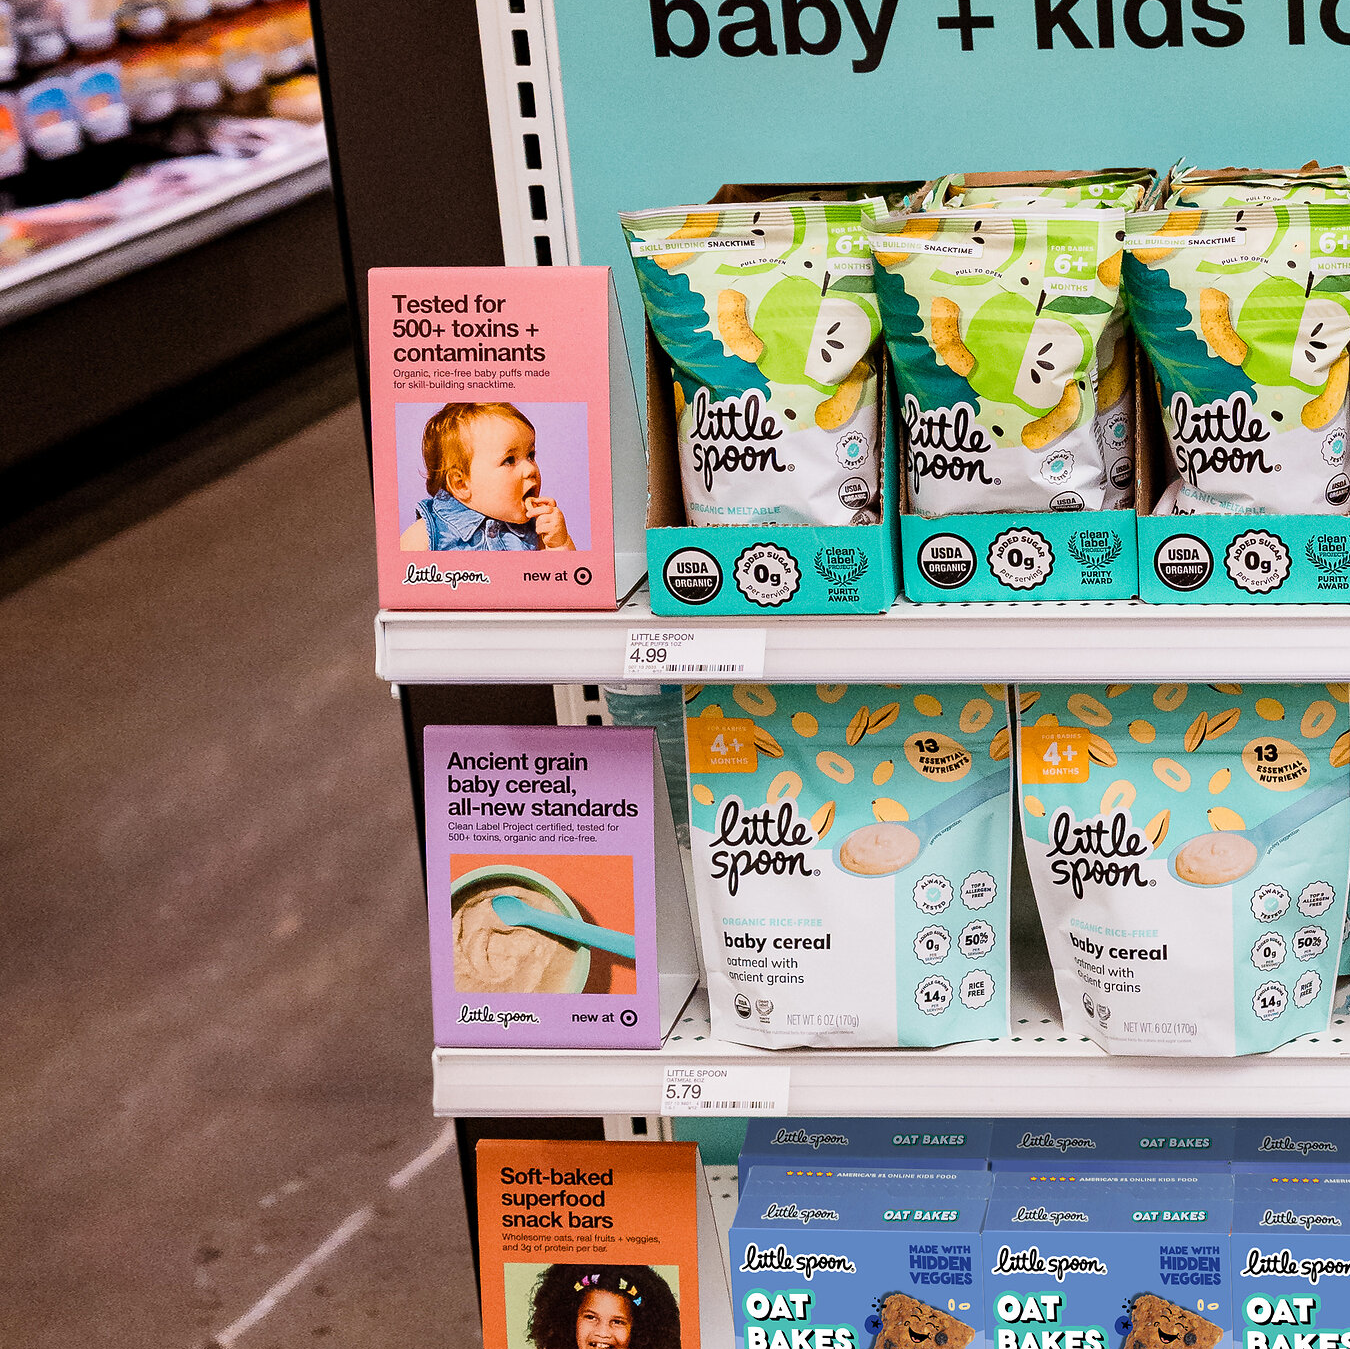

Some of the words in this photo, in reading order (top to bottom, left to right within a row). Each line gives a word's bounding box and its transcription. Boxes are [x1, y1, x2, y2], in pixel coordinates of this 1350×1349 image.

[640, 244, 663, 252] SKILL
[665, 241, 705, 250] BUILDING
[708, 239, 756, 248] SNACKTIME
[392, 295, 468, 314] Tested
[474, 295, 506, 314] for
[393, 319, 446, 338] 500+
[452, 319, 519, 338] toxins
[526, 324, 539, 336] +
[393, 343, 546, 362] contaminants
[393, 369, 430, 379] Organic,
[433, 369, 472, 378] rice-free
[474, 369, 496, 379] baby
[500, 369, 522, 379] puffs
[524, 369, 550, 378] made
[393, 381, 406, 389] for
[408, 380, 465, 391] skill-building
[467, 381, 516, 389] snacktime.
[690, 392, 783, 441] little
[404, 565, 443, 583] little
[677, 562, 708, 573] USDA
[754, 564, 781, 586] 0g
[524, 572, 551, 581] new
[555, 571, 568, 581] at
[675, 579, 713, 588] ORGANIC
[630, 648, 667, 663] 4.99
[915, 739, 939, 753] 13
[447, 752, 529, 771] Ancient
[534, 753, 588, 774] grain
[919, 752, 964, 764] ESSENTIAL
[923, 757, 969, 773] NUTRIENTS
[448, 775, 500, 797] baby
[505, 777, 577, 796] cereal,
[448, 799, 524, 816] all-new
[531, 799, 638, 817] standards
[448, 823, 473, 831] Clean
[476, 823, 499, 831] Label
[503, 823, 533, 833] Project
[536, 823, 574, 833] certified,
[577, 823, 604, 832] tested
[607, 823, 619, 832] for
[709, 800, 812, 848] little
[448, 833, 470, 842] 500+
[473, 833, 501, 843] toxins,
[504, 834, 536, 844] organic
[539, 834, 555, 842] and
[558, 834, 597, 843] rice-free.
[723, 918, 765, 926] ORGANIC
[770, 918, 822, 926] RICE-FREE
[724, 932, 767, 953] baby
[773, 934, 831, 950] cereal
[727, 957, 768, 968] oatmeal
[771, 958, 798, 968] with
[729, 971, 763, 982] ancient
[767, 973, 804, 985] grains
[787, 1015, 800, 1025] NET
[803, 1015, 814, 1025] WT
[817, 1015, 822, 1025] 6
[824, 1015, 834, 1025] OZ
[836, 1015, 859, 1027] (170g)
[666, 1085, 703, 1100] 5.79
[501, 1168, 613, 1186] Soft-baked
[501, 1191, 605, 1211] superfood
[502, 1212, 564, 1229] snack
[568, 1212, 613, 1229] bars
[502, 1233, 551, 1241] Wholesome
[626, 1236, 660, 1244] veggies,
[909, 1244, 940, 1255] MADE
[944, 1245, 970, 1255] WITH
[742, 1245, 794, 1270] little
[909, 1254, 972, 1271] HIDDEN
[909, 1271, 973, 1285] VEGGIES
[745, 1292, 810, 1321] OAT
